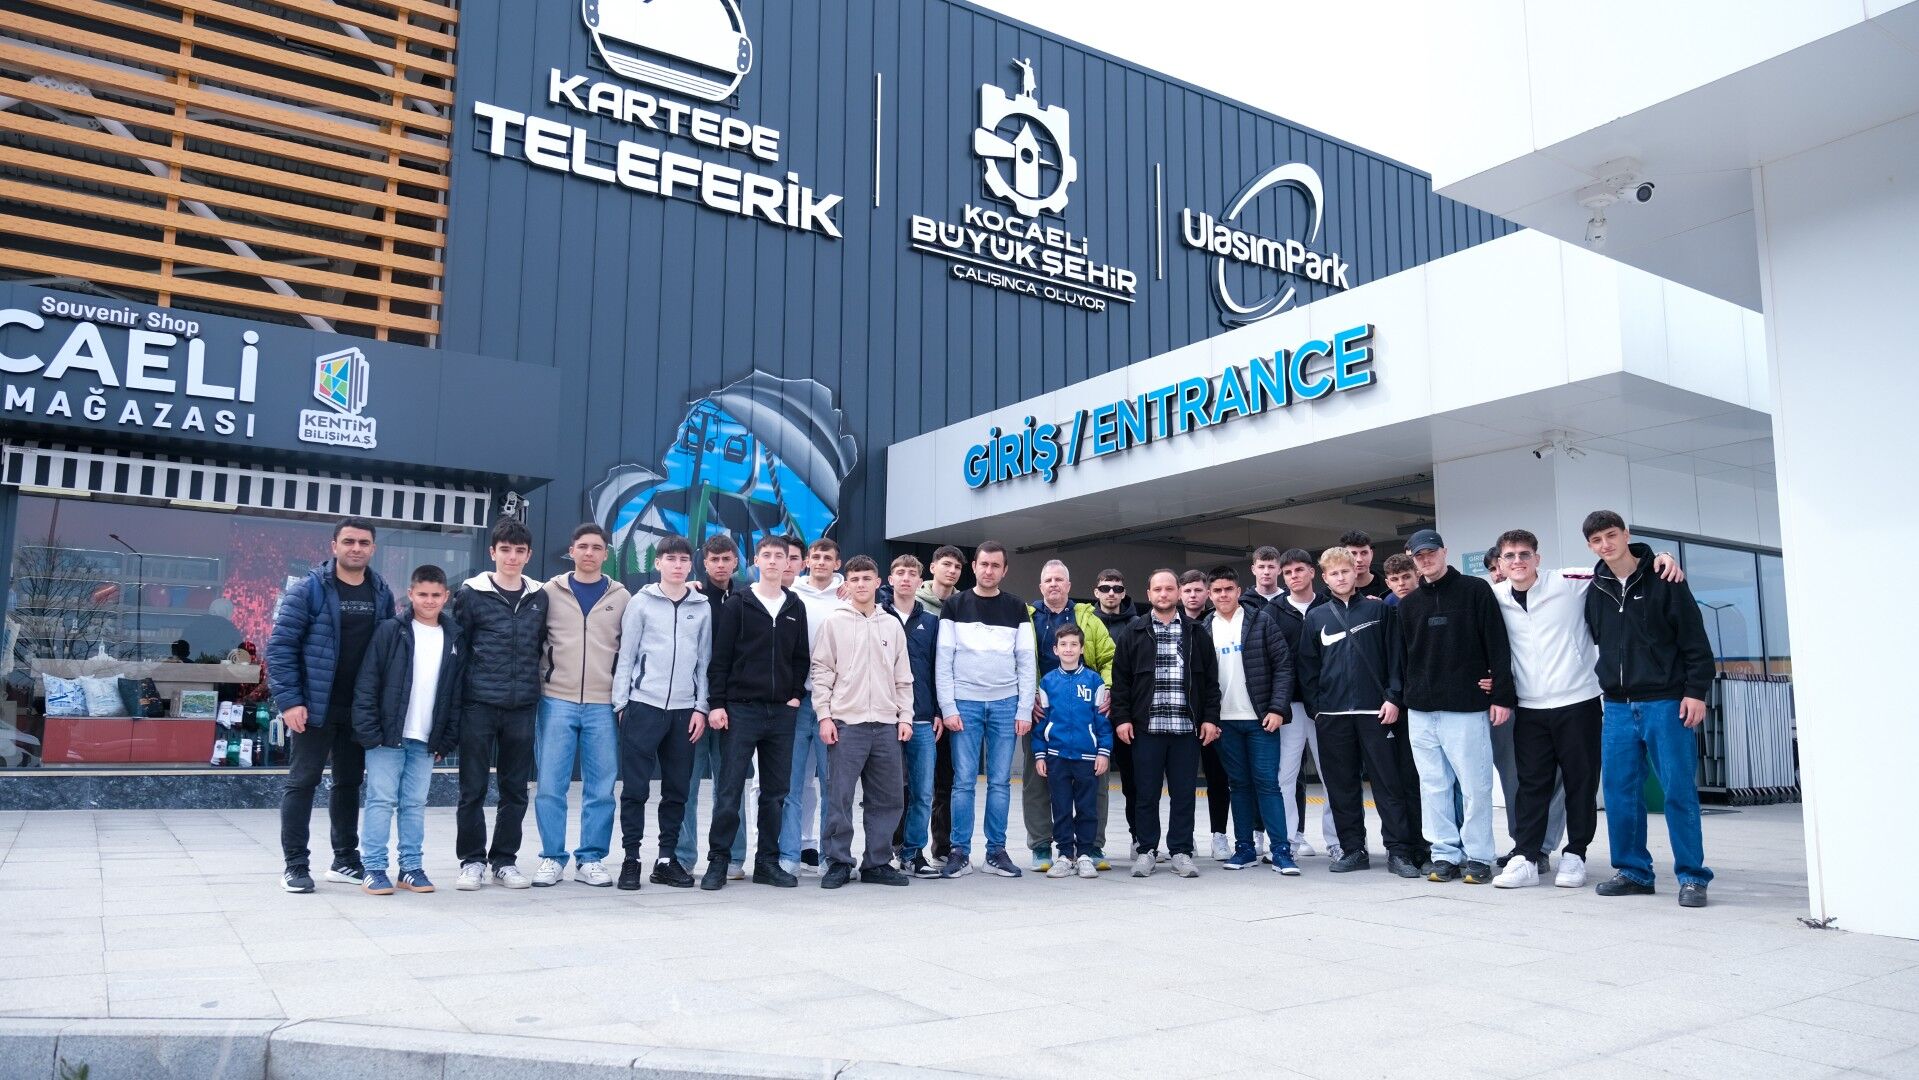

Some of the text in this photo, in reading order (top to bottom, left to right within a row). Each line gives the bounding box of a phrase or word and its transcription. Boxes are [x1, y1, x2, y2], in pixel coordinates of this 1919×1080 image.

[549, 68, 780, 161] KARTEPE
[953, 264, 1106, 311] ÇALIŞINCA OLUYOR
[41, 296, 200, 337] Souvenir Shop
[4, 384, 256, 438] MAĞAZASI
[963, 416, 1060, 489] GİRİŞ
[1093, 323, 1372, 456] ENTRANCE
